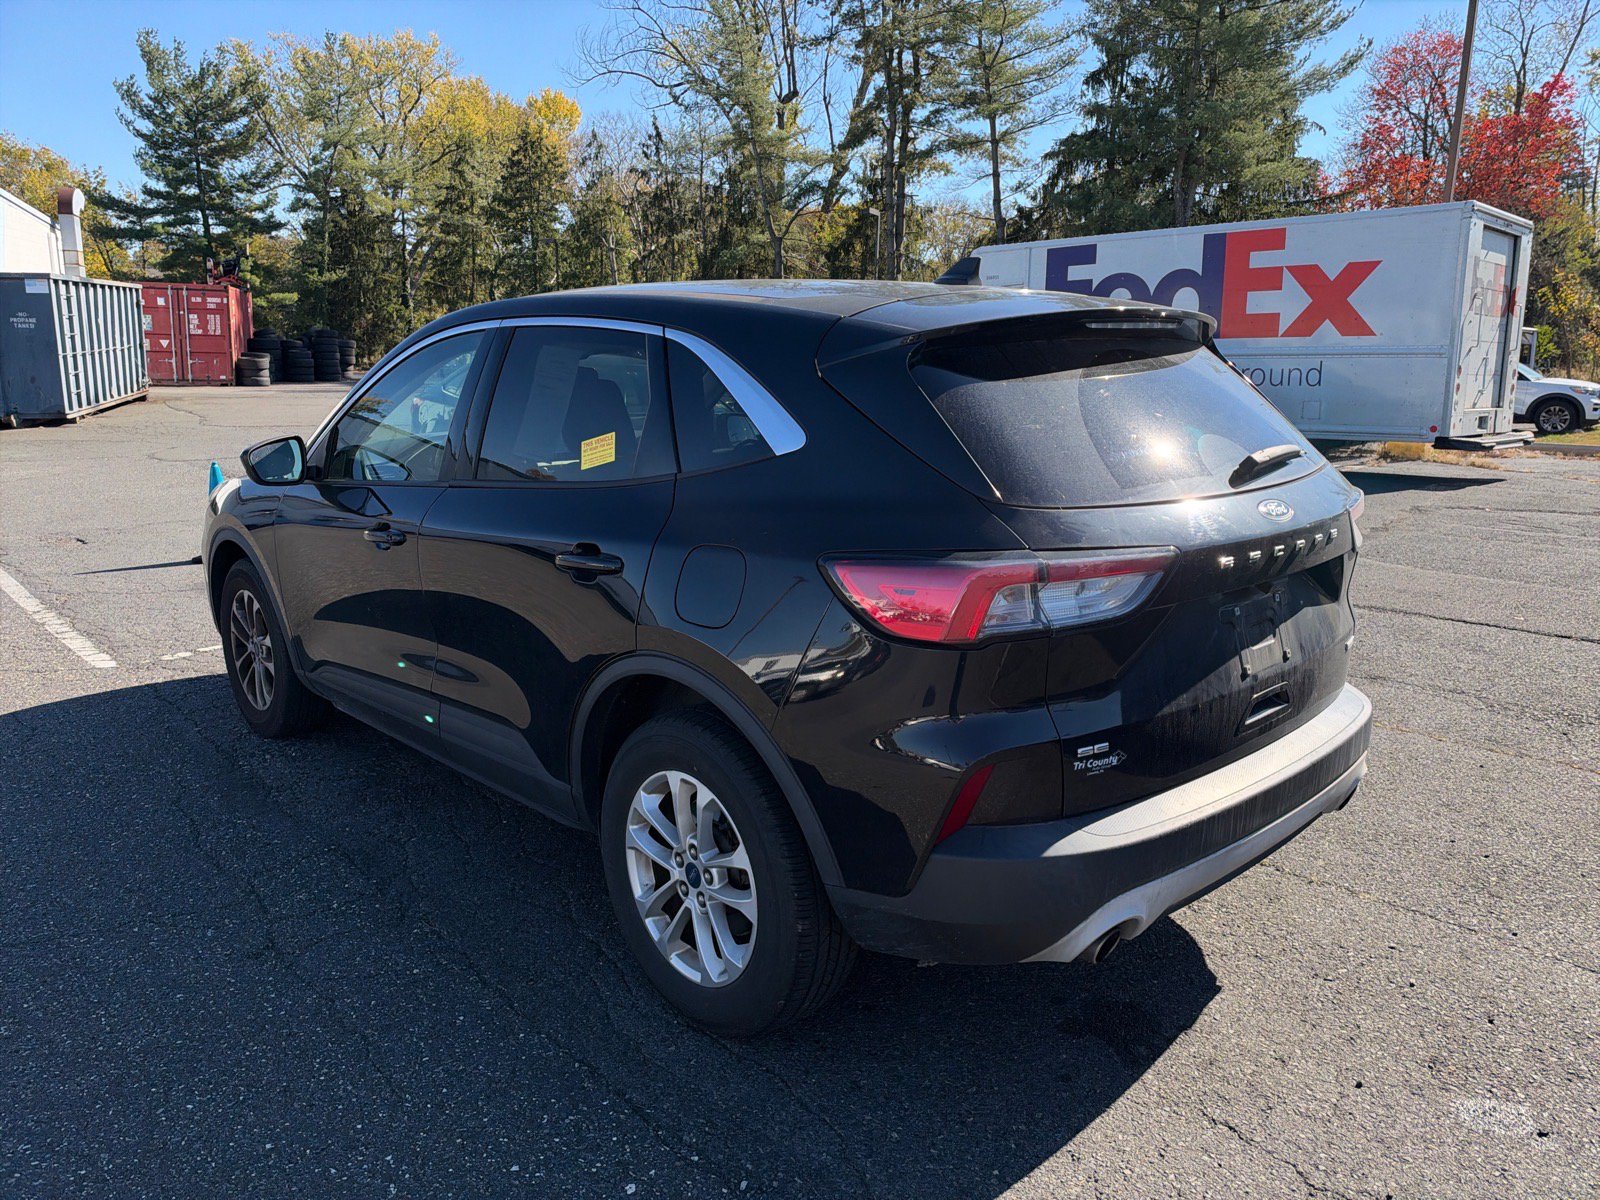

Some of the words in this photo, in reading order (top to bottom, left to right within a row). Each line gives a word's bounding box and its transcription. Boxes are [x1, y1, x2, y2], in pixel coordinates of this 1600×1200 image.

[1236, 360, 1323, 387] round
[583, 440, 593, 449] THIS
[594, 434, 613, 445] VEHICLE
[1078, 742, 1109, 757] SE
[1074, 760, 1086, 770] Tri
[1087, 756, 1118, 768] County
